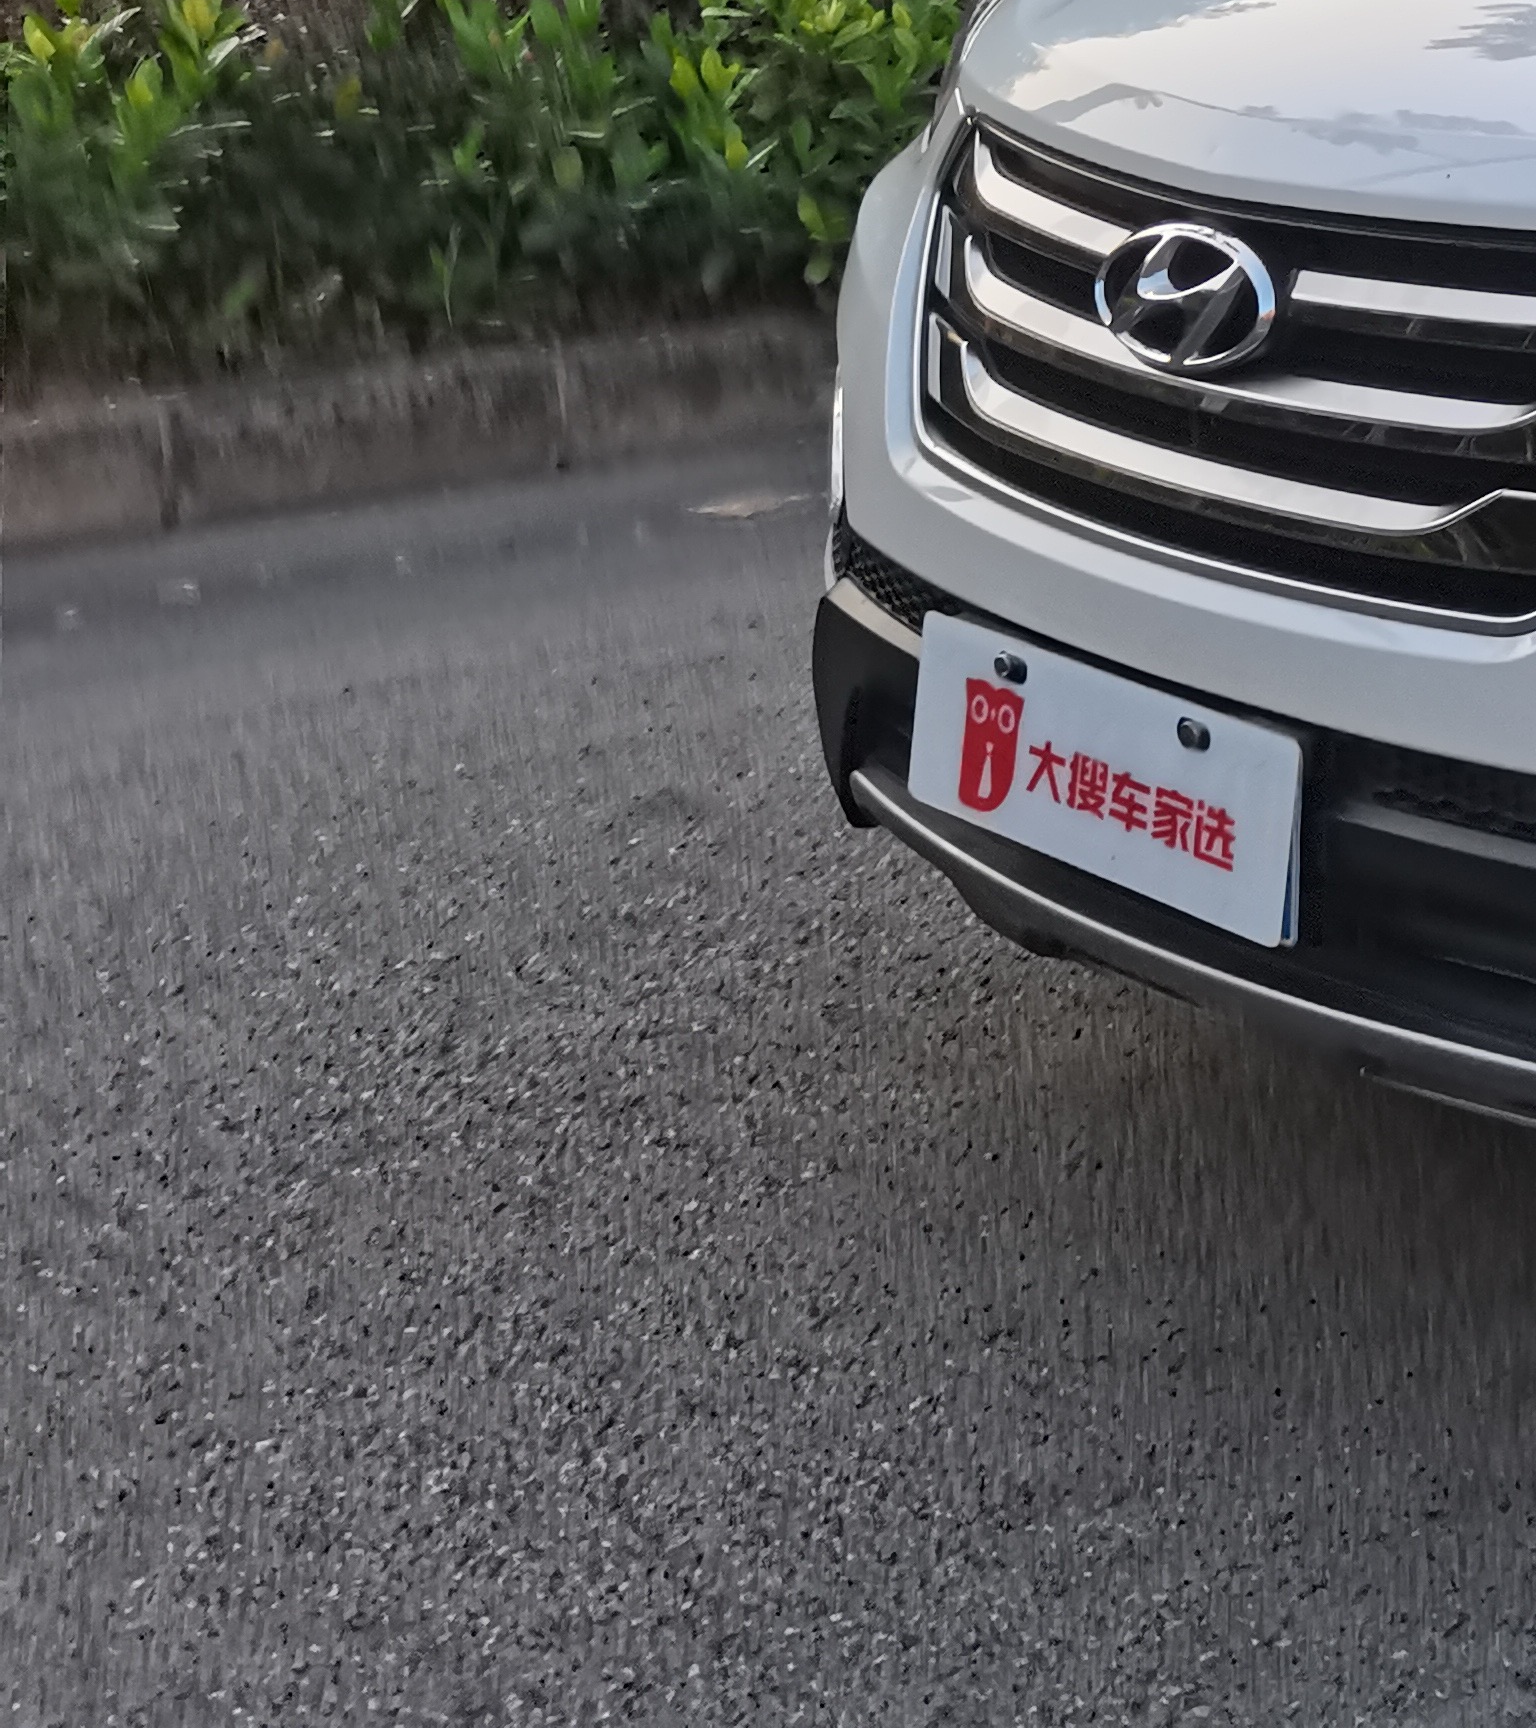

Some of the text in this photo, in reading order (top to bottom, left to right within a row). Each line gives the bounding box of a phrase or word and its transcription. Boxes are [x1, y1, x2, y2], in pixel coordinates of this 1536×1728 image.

[1026, 741, 1235, 872] 大搜车家选
